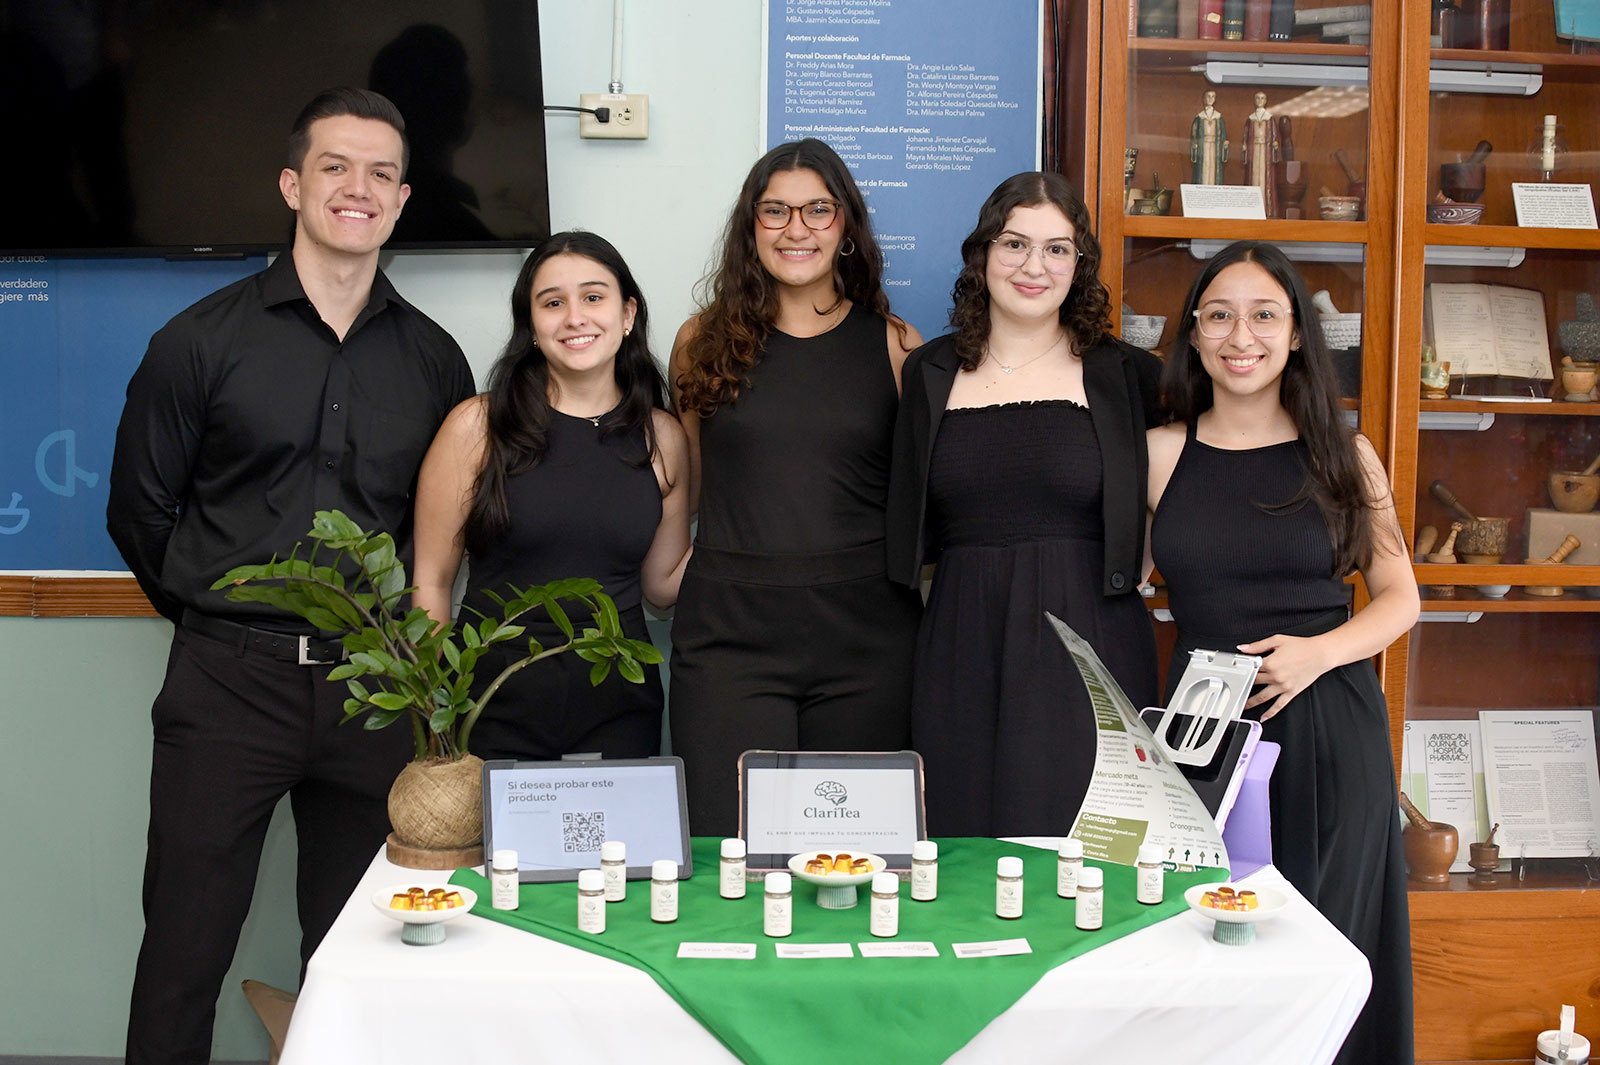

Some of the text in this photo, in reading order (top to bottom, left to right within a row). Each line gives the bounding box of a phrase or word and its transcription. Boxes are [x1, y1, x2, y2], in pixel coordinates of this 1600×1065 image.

[824, 8, 842, 16] Rojas
[842, 8, 875, 16] Céspedes
[850, 17, 881, 25] González
[785, 34, 812, 42] Aportes
[817, 34, 860, 42] colaboración
[814, 52, 841, 60] Docente
[796, 61, 820, 70] Freddy
[921, 64, 941, 72] Angie
[958, 64, 976, 72] Salas
[800, 70, 819, 79] Jeimy
[842, 71, 873, 79] Barrantes
[947, 73, 969, 81] Lizano
[795, 79, 822, 87] Gustavo
[920, 82, 945, 90] Wendy
[945, 82, 974, 91] Montoya
[974, 83, 997, 91] Vargas
[785, 88, 799, 96] Dra.
[799, 89, 826, 97] Eugenia
[917, 90, 942, 98] Alfonso
[965, 91, 998, 100] Céspedes
[785, 97, 799, 105] Dra.
[939, 100, 967, 108] Soledad
[795, 106, 818, 114] Olman
[818, 107, 844, 115] Hidalgo
[844, 107, 868, 115] Muñoz
[784, 124, 813, 132] Personal
[813, 125, 860, 133] Administrativo
[860, 125, 889, 133] Facultad
[898, 126, 931, 134] Farmacia:
[827, 134, 857, 143] Delgado
[906, 135, 988, 145] Johanna Jiménez Carvajal
[833, 143, 862, 151] Valverde
[905, 144, 937, 152] Fernando
[963, 145, 997, 154] Céspedes
[866, 152, 894, 160] Barboza
[905, 153, 974, 162] Mayra Morales Núñez
[905, 162, 971, 171] Gerardo Rojas López
[0, 278, 49, 289] verdadero
[27, 291, 49, 301] más
[1427, 740, 1470, 748] JOURNAL OF
[1094, 770, 1123, 779] Mercado
[507, 779, 614, 790] Si desea probar este
[508, 793, 557, 804] producto
[803, 807, 861, 819] ClariTea
[1082, 813, 1117, 825] Contacto
[1169, 821, 1205, 832] Cronograma
